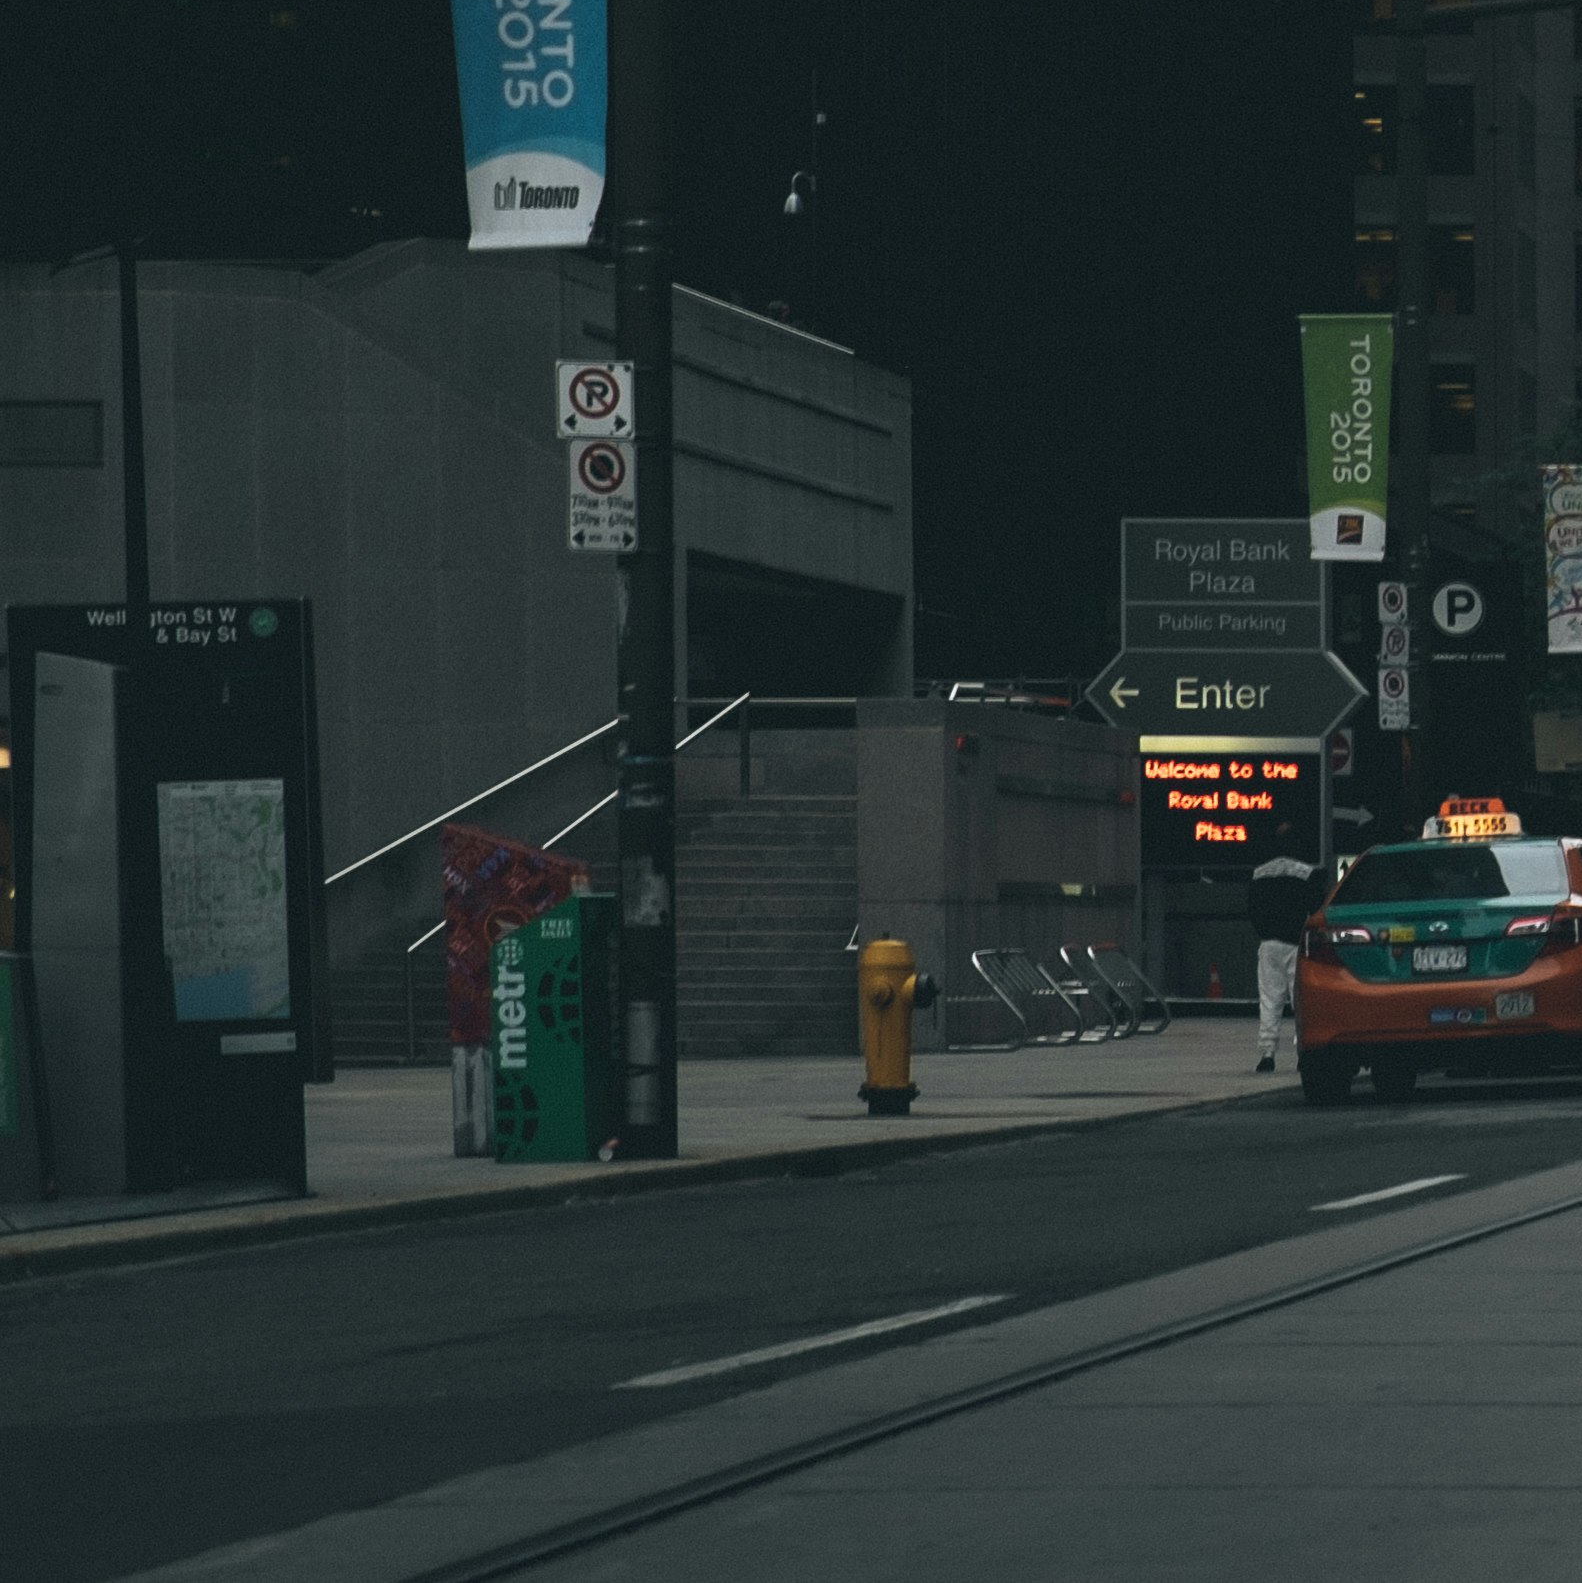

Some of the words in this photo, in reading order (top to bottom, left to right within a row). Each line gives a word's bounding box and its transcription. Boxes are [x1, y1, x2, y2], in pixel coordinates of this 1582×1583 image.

[519, 180, 580, 210] TORONTO
[1350, 334, 1373, 484] TORONTO
[1330, 411, 1351, 483] 2015
[1154, 538, 1221, 567] Royal
[1230, 538, 1291, 562] Bank
[1188, 570, 1256, 594] Plaza
[193, 607, 212, 624] St
[218, 607, 237, 623] W
[1447, 589, 1475, 627] P
[155, 628, 169, 644] &
[175, 627, 211, 647] Bay
[217, 625, 237, 643] St
[1158, 612, 1212, 632] Public
[1218, 612, 1287, 636] Parking
[1175, 676, 1272, 710] Enter
[1145, 760, 1221, 779] Welcome
[1229, 761, 1254, 779] to
[1262, 761, 1299, 780] the
[1168, 790, 1219, 810] Royal
[1226, 790, 1273, 810] Bank
[1449, 801, 1490, 815] BECK
[1195, 821, 1248, 842] Plaza
[1436, 817, 1507, 835] 751-5555
